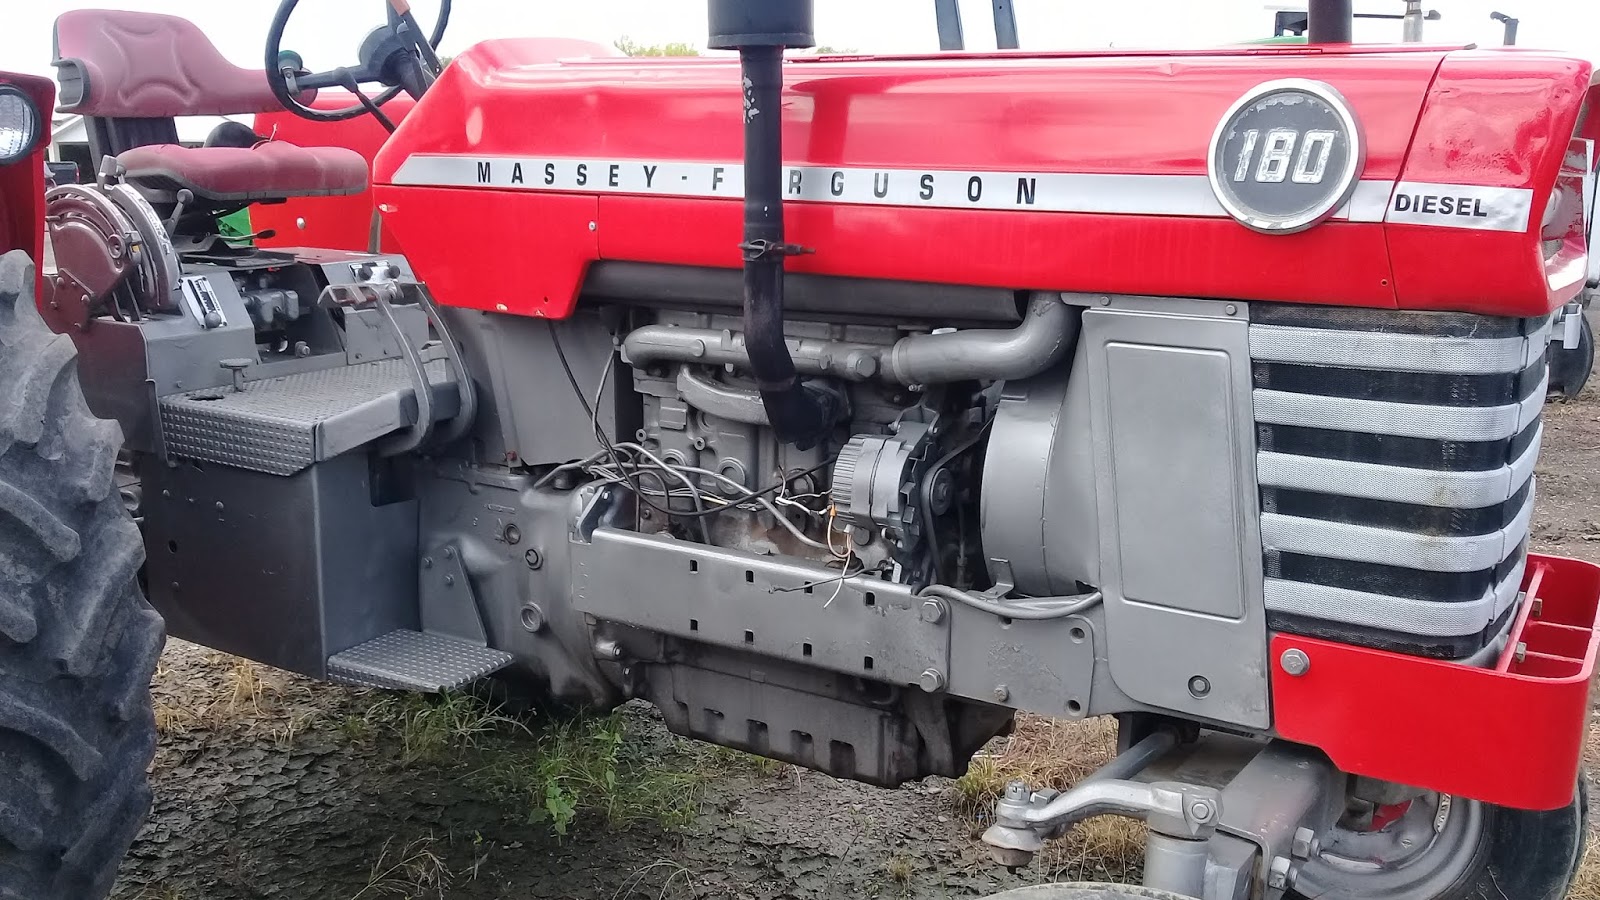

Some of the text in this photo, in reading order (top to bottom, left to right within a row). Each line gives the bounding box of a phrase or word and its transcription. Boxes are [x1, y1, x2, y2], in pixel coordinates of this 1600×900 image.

[1234, 127, 1337, 183] 180
[477, 161, 1036, 204] MASSEY-FRGUSON
[1394, 193, 1487, 217] DIESEL
